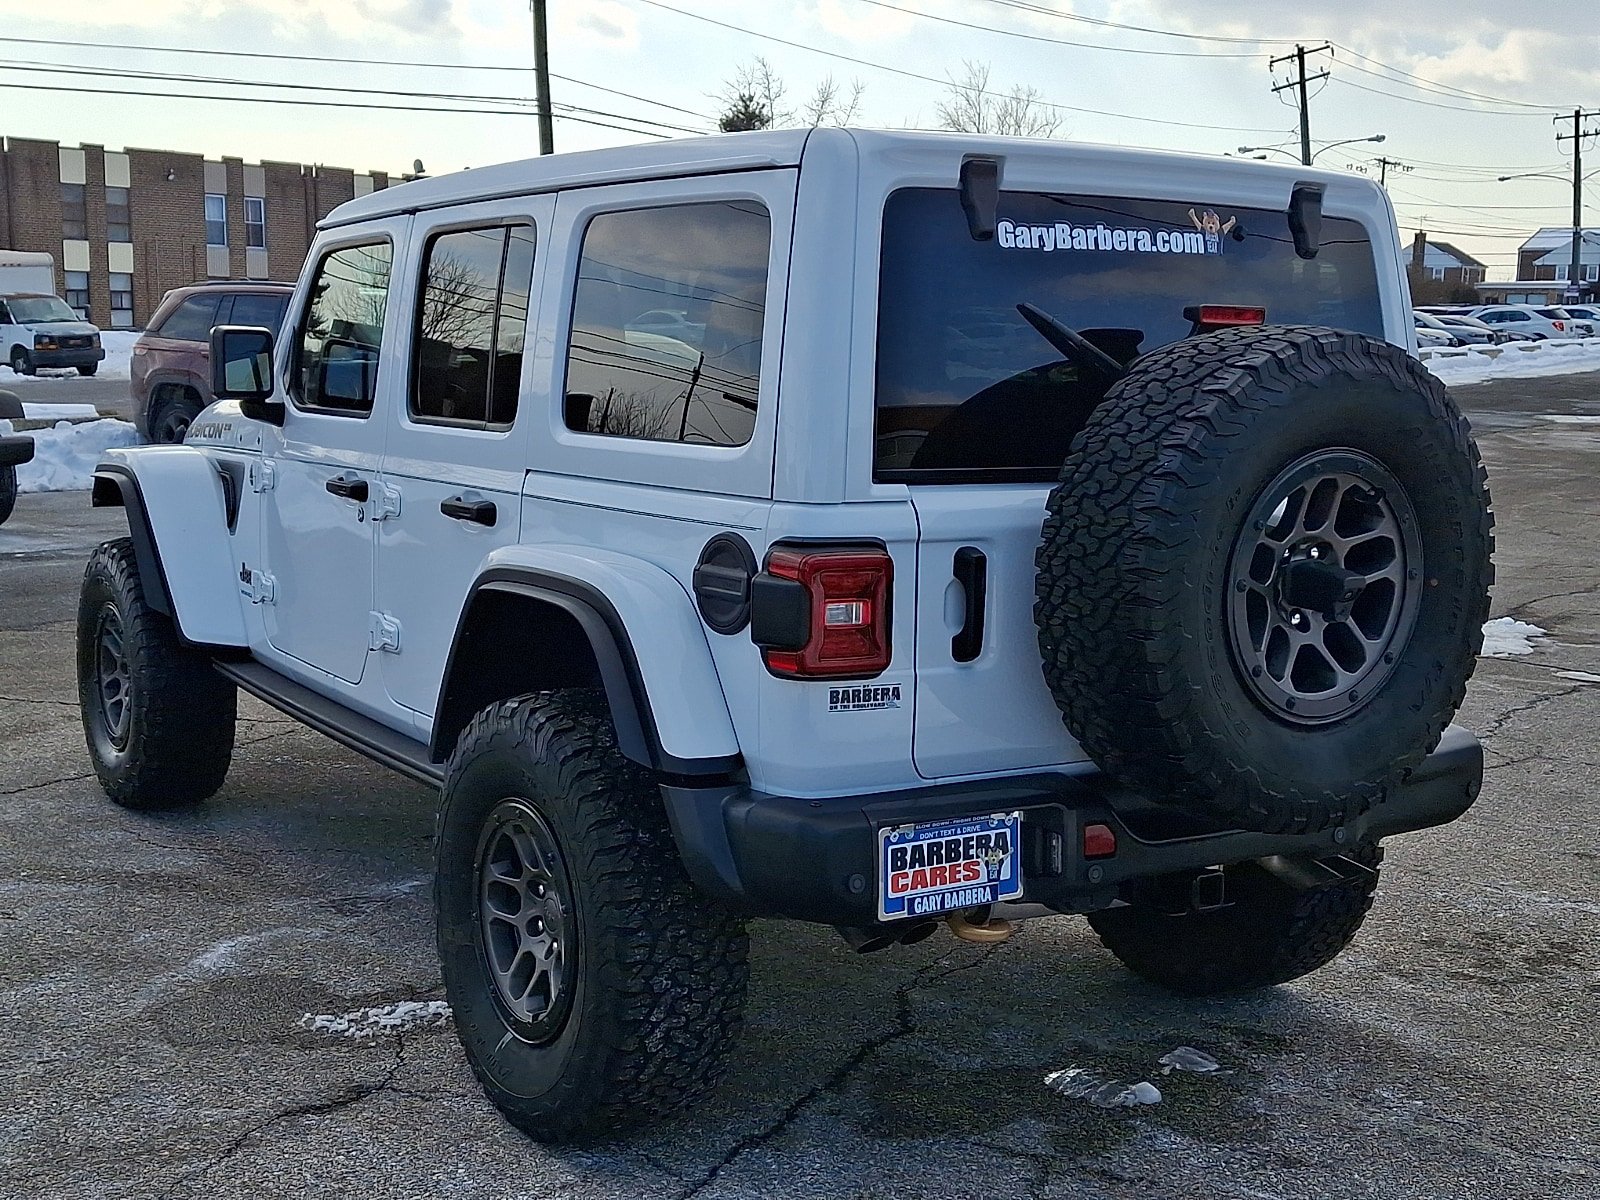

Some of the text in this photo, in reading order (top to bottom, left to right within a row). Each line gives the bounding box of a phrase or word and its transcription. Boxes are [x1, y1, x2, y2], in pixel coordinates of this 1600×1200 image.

[997, 220, 1205, 254] GaryBarbera.com
[829, 686, 901, 704] BARBERA
[919, 830, 939, 840] DON'T
[940, 828, 955, 837] TEXT
[962, 824, 981, 834] DRIVE
[890, 831, 1009, 872] BARBERA
[890, 860, 980, 893] CARES
[914, 886, 992, 913] GARY BARBERA
